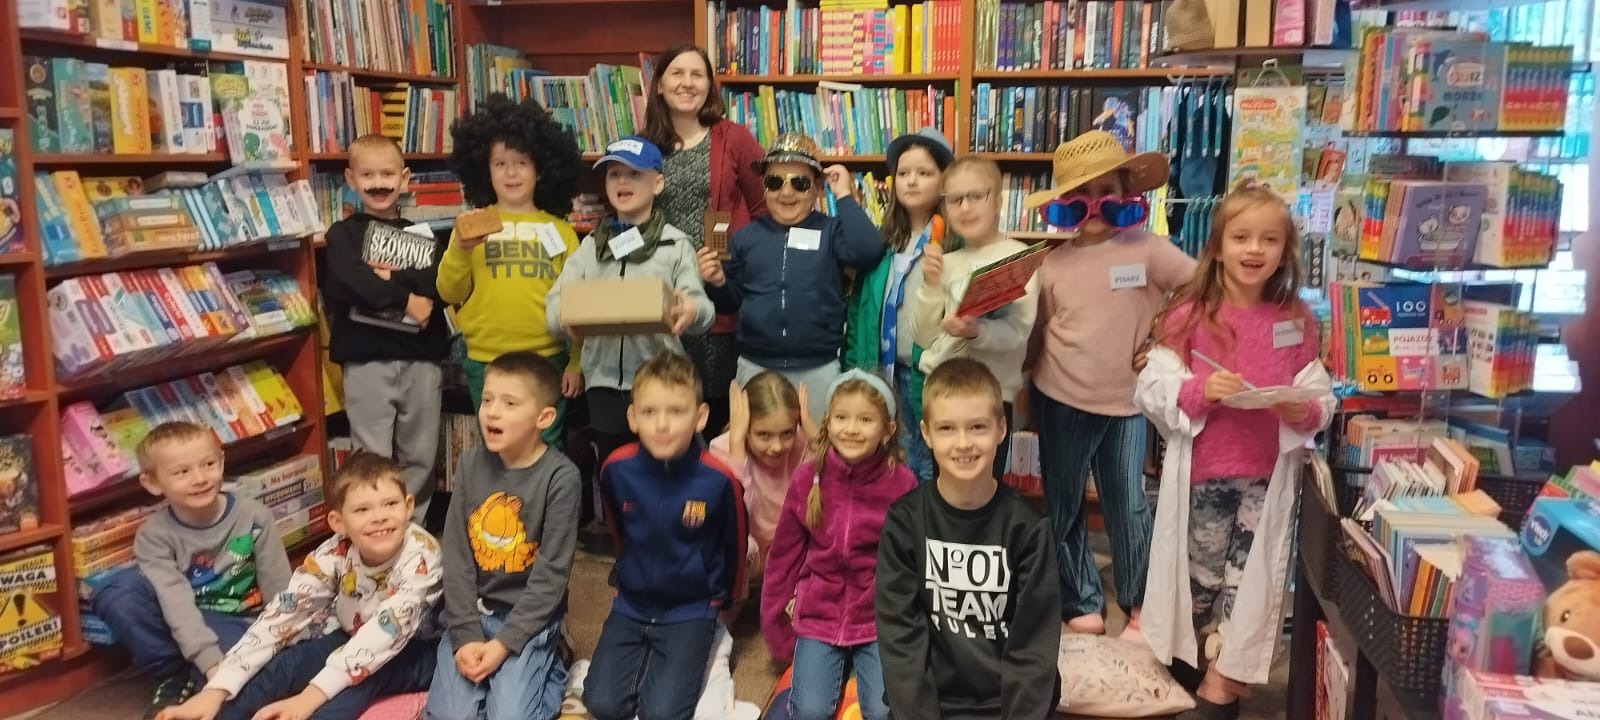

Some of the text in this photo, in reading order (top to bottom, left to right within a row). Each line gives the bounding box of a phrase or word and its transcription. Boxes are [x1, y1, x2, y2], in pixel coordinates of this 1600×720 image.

[1450, 71, 1481, 82] QUIZ
[370, 233, 434, 267] SŁOWNIK
[485, 240, 553, 259] BEN
[486, 260, 559, 281] TTON
[1396, 300, 1426, 313] 100
[0, 570, 47, 586] WAGA
[925, 582, 1008, 623] TEAM
[0, 620, 59, 650] POILER!
